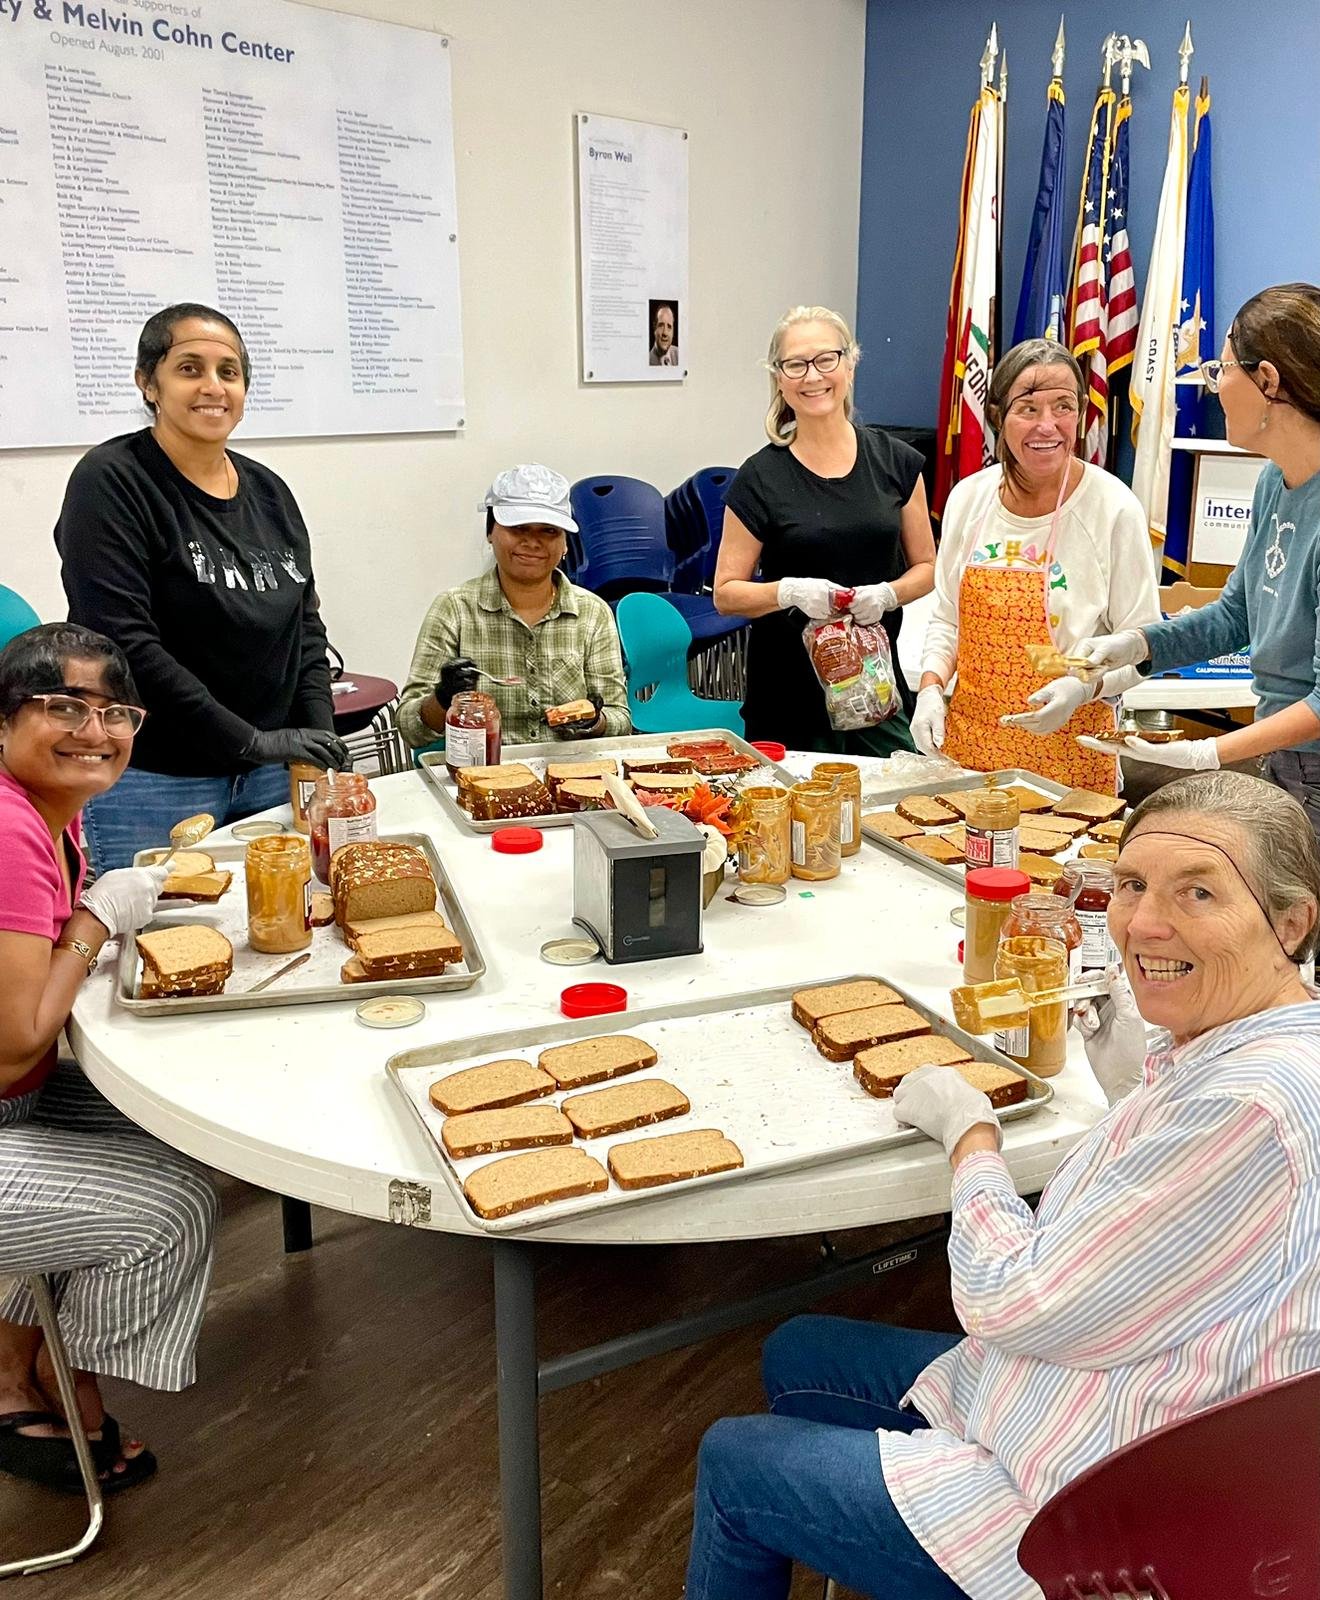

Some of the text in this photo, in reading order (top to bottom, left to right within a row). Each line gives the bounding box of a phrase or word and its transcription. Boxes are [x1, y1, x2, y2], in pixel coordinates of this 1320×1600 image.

[33, 0, 53, 21] &
[62, 1, 143, 37] Melvin
[152, 18, 213, 49] Cohn
[221, 31, 295, 63] Center
[50, 31, 96, 50] Opened
[142, 46, 165, 61] 2001
[588, 147, 613, 161] Byron
[1146, 339, 1157, 383] COAST
[878, 1253, 912, 1270] LIFETIME
